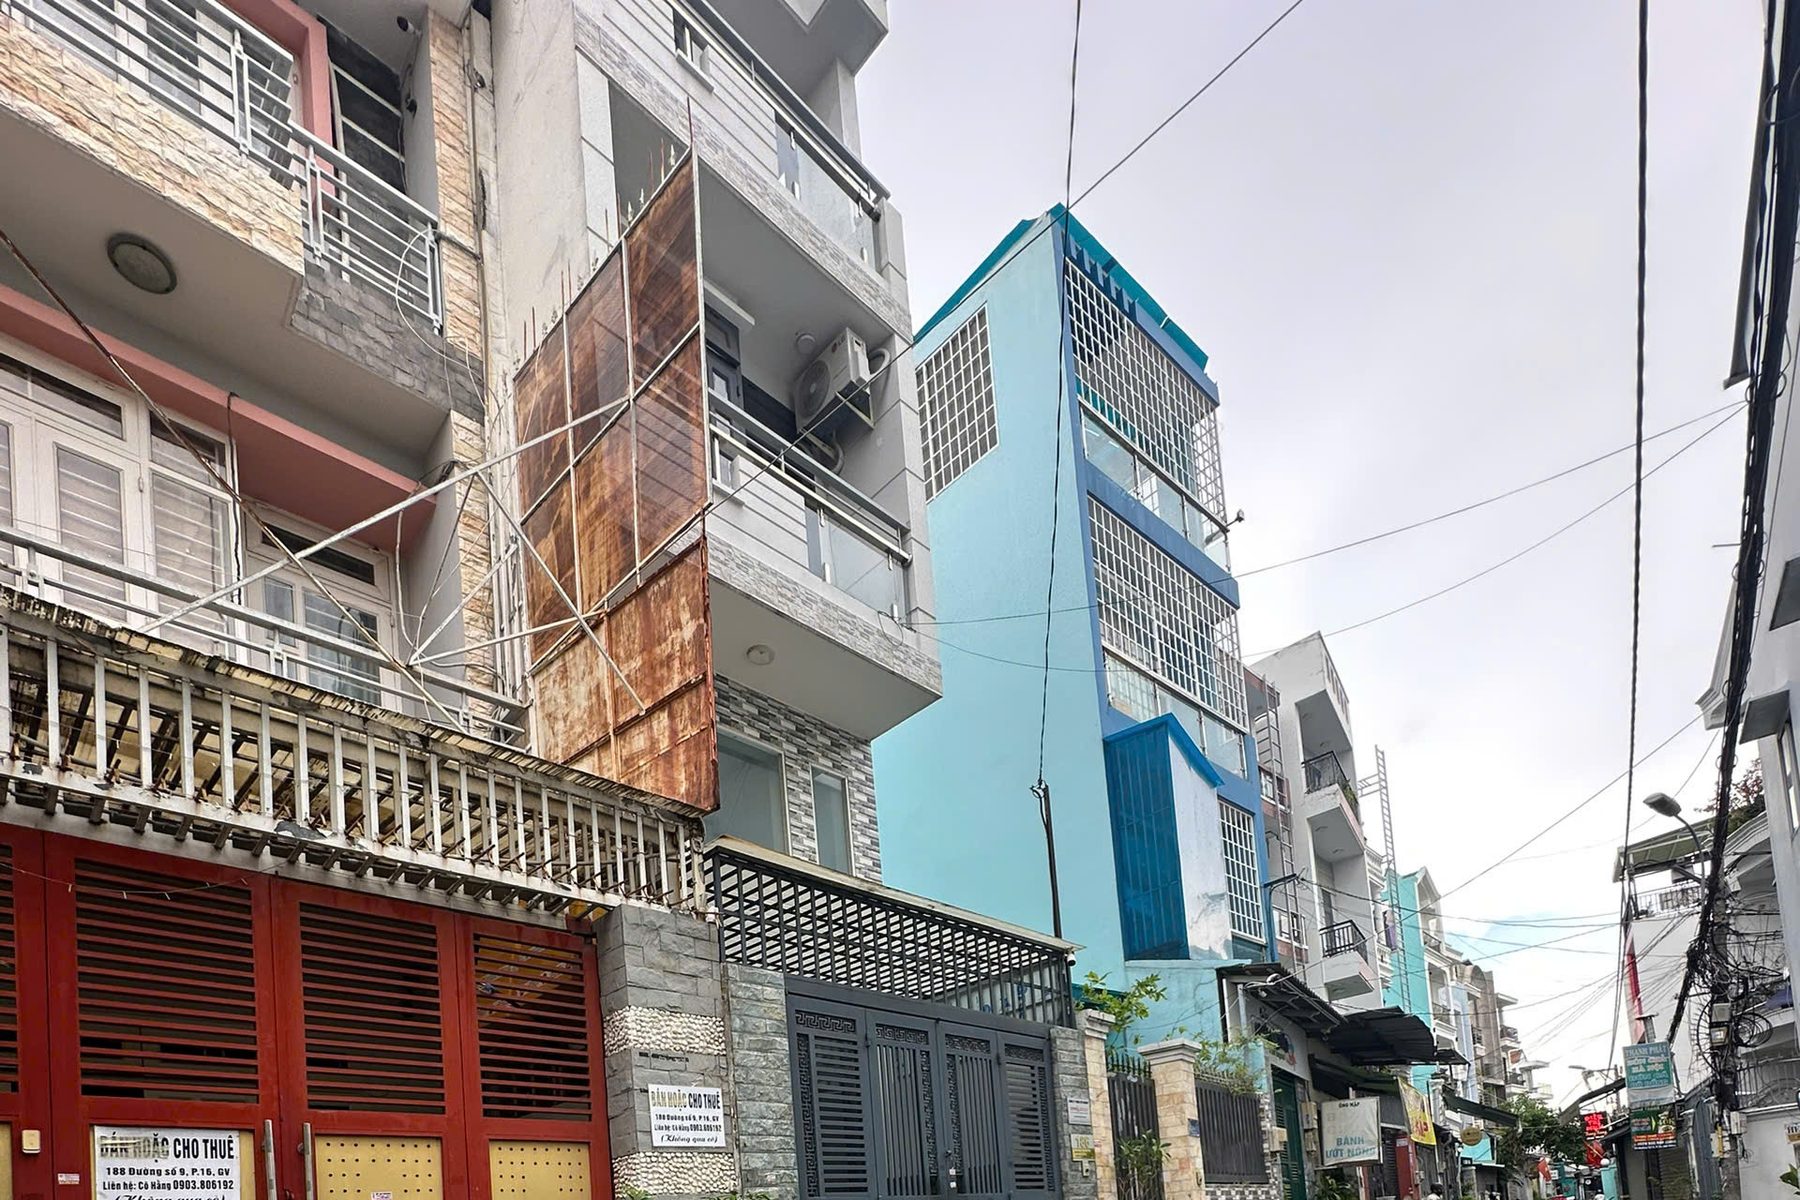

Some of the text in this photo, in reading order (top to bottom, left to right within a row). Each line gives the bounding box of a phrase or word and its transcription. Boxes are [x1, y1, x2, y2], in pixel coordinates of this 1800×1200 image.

[688, 1092, 702, 1109] CHO
[703, 1091, 721, 1109] THUÊ
[173, 1138, 199, 1159] CHO
[202, 1135, 234, 1159] THUÊ
[106, 1167, 126, 1176] 188
[129, 1167, 162, 1177] Đường
[165, 1166, 177, 1176] số
[218, 1168, 230, 1176] GV
[103, 1181, 121, 1190] Liên
[123, 1181, 136, 1192] hệ:
[138, 1181, 149, 1190] Cô
[173, 1180, 234, 1190] 0903.806192
